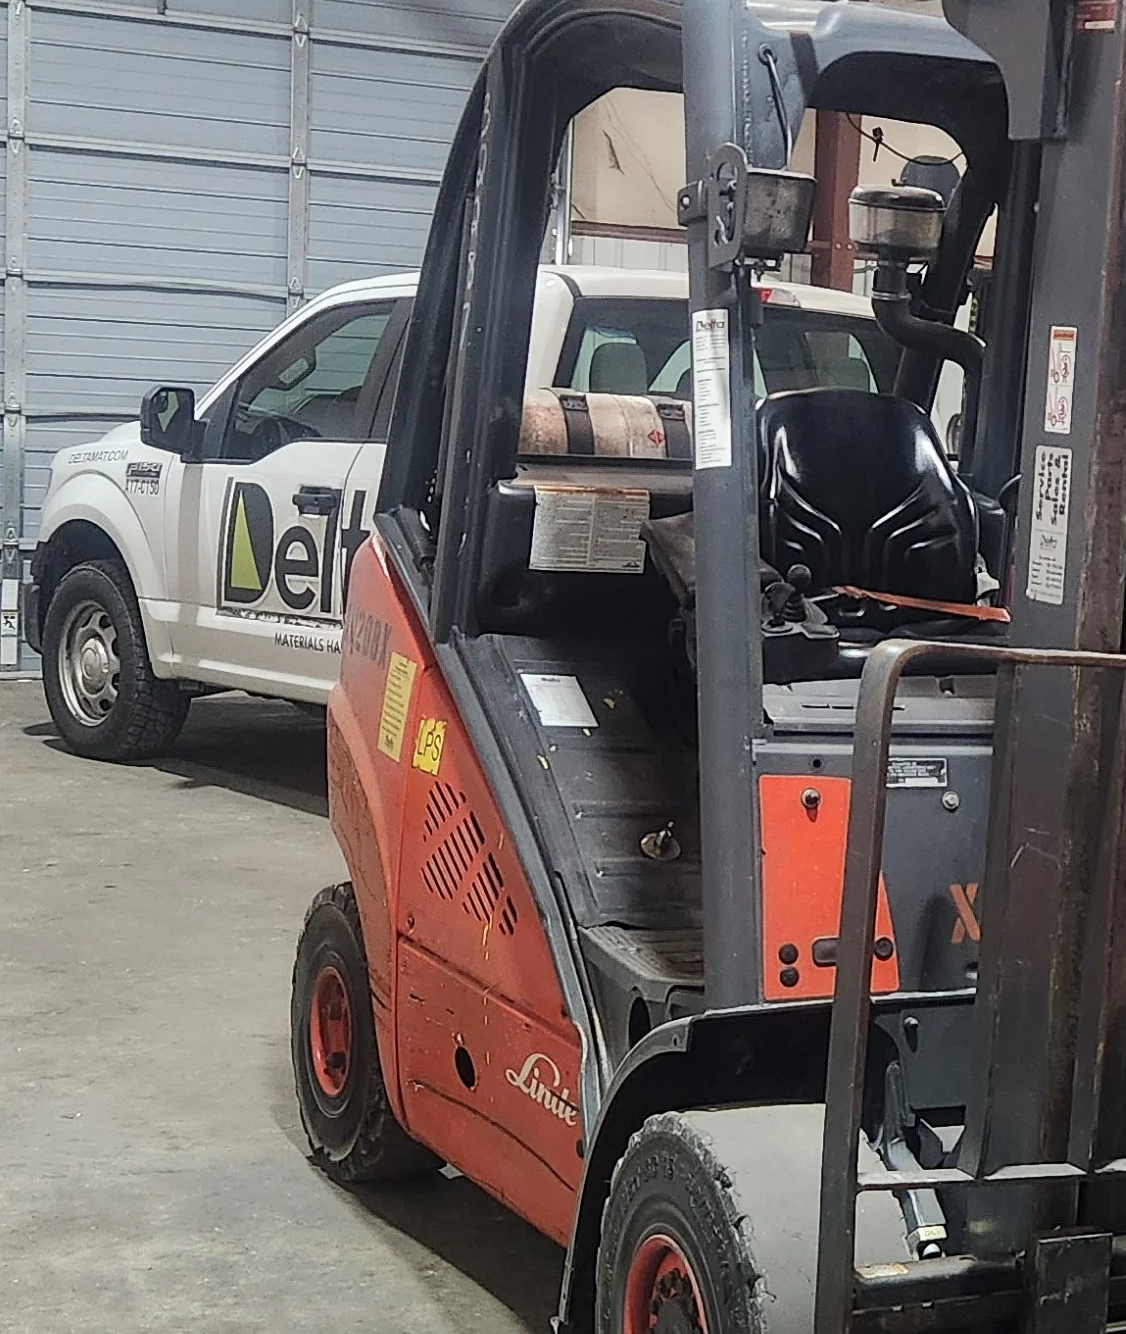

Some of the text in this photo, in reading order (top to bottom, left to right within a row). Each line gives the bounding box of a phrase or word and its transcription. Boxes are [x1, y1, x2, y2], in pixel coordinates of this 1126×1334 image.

[1036, 451, 1047, 520] Service
[1045, 453, 1054, 501] Parts
[1051, 477, 1061, 526] Sales
[1059, 454, 1069, 515] Rental
[274, 632, 324, 652] MATERIALS
[417, 730, 442, 761] LPS
[505, 1053, 577, 1126] Linde
